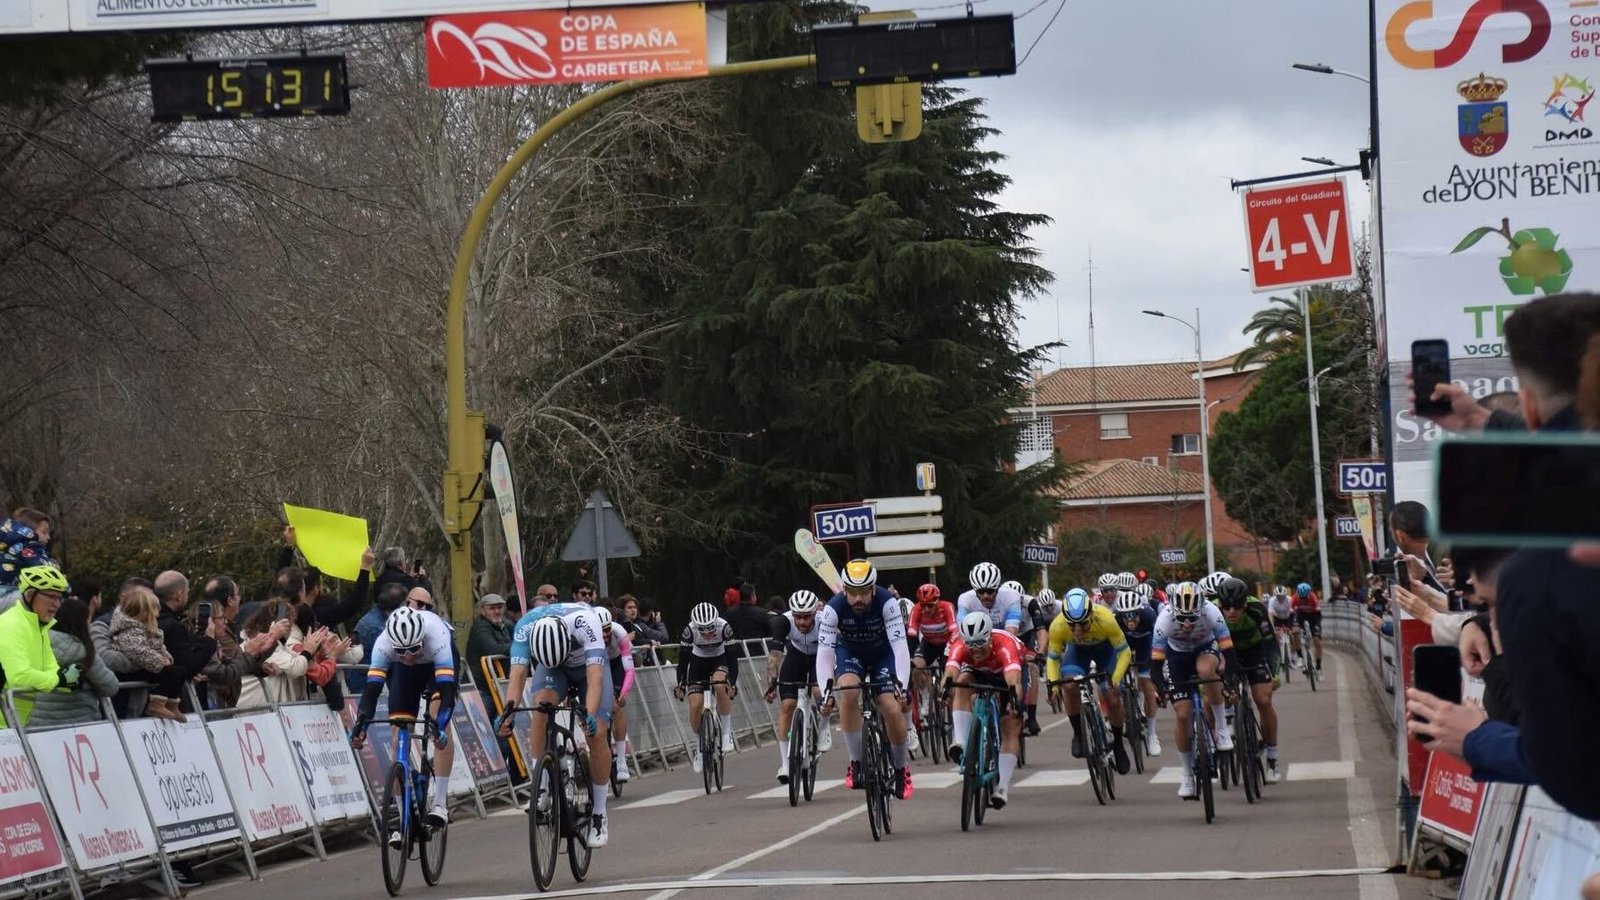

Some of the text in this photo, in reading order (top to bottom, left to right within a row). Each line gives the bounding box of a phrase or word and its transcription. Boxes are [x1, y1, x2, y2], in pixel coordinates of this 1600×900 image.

[559, 15, 618, 33] COPA
[560, 30, 679, 53] DE ESPAÑA
[1570, 45, 1590, 58] de
[561, 59, 662, 79] CARRETERA
[1545, 127, 1593, 142] DMD
[1249, 189, 1341, 209] Circuito del Guadiana
[1258, 209, 1341, 271] 4-V
[822, 513, 870, 536] 50m
[1339, 519, 1361, 534] 100
[1026, 546, 1056, 562] 100m
[1161, 551, 1185, 562] 150m
